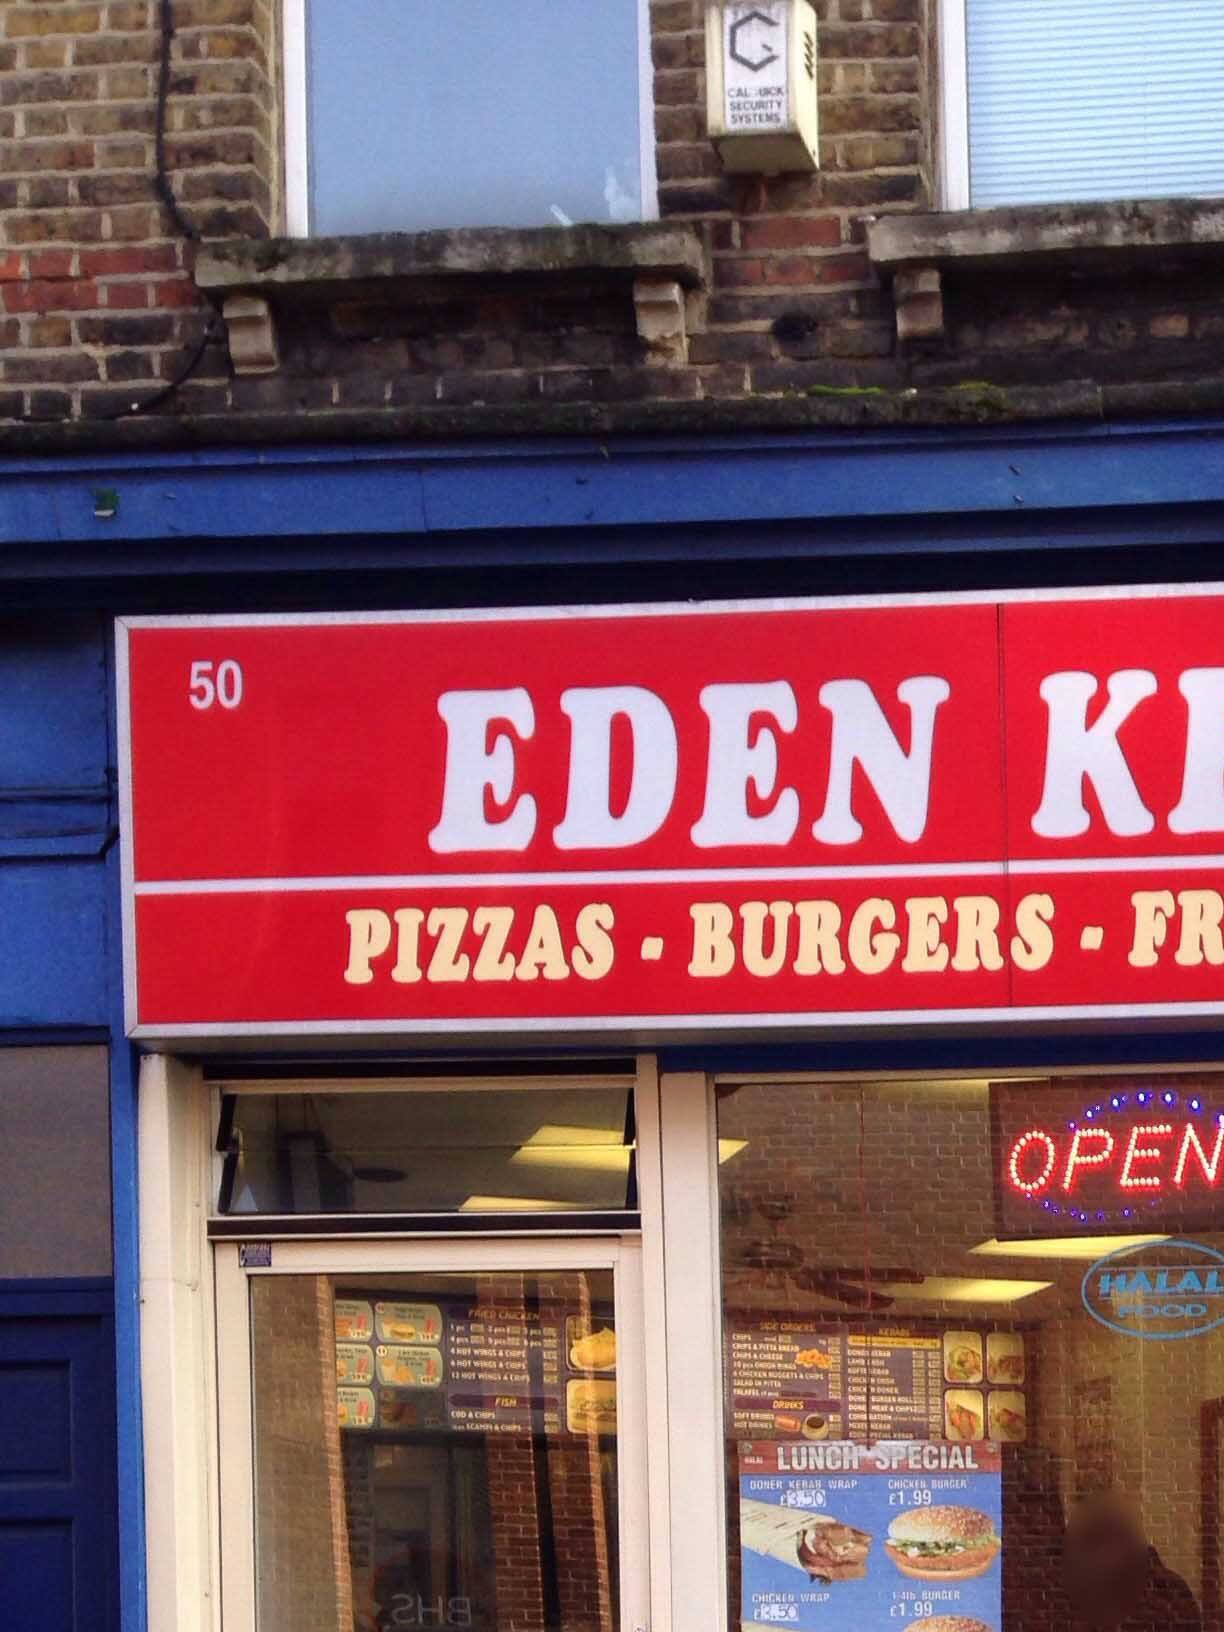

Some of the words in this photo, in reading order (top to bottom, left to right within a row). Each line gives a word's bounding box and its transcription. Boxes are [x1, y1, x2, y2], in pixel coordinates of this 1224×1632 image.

[730, 100, 782, 112] SECURITY
[731, 112, 781, 124] SYSTEMS
[188, 659, 244, 710] 50
[427, 675, 951, 855] EDEN
[343, 902, 616, 985] PIZZAS
[687, 892, 1056, 979] BURGERS
[1119, 1303, 1209, 1319] FOOD
[733, 1343, 751, 1351] CHIPS
[495, 1396, 517, 1408] FISH
[773, 1400, 805, 1410] DRINKS
[777, 1445, 860, 1471] LUNCH
[874, 1444, 979, 1471] SPECIAL
[749, 1479, 783, 1490] DONER
[788, 1479, 822, 1490] KEBAB
[828, 1479, 858, 1490] WRAP
[887, 1479, 927, 1490] CHICKEN
[930, 1479, 968, 1490] BURGER
[888, 1488, 933, 1506] £1.99
[751, 1592, 796, 1604] CHICKEN
[800, 1592, 831, 1604] WRAP
[921, 1589, 961, 1601] BURGER
[889, 1600, 934, 1617] £1.99
